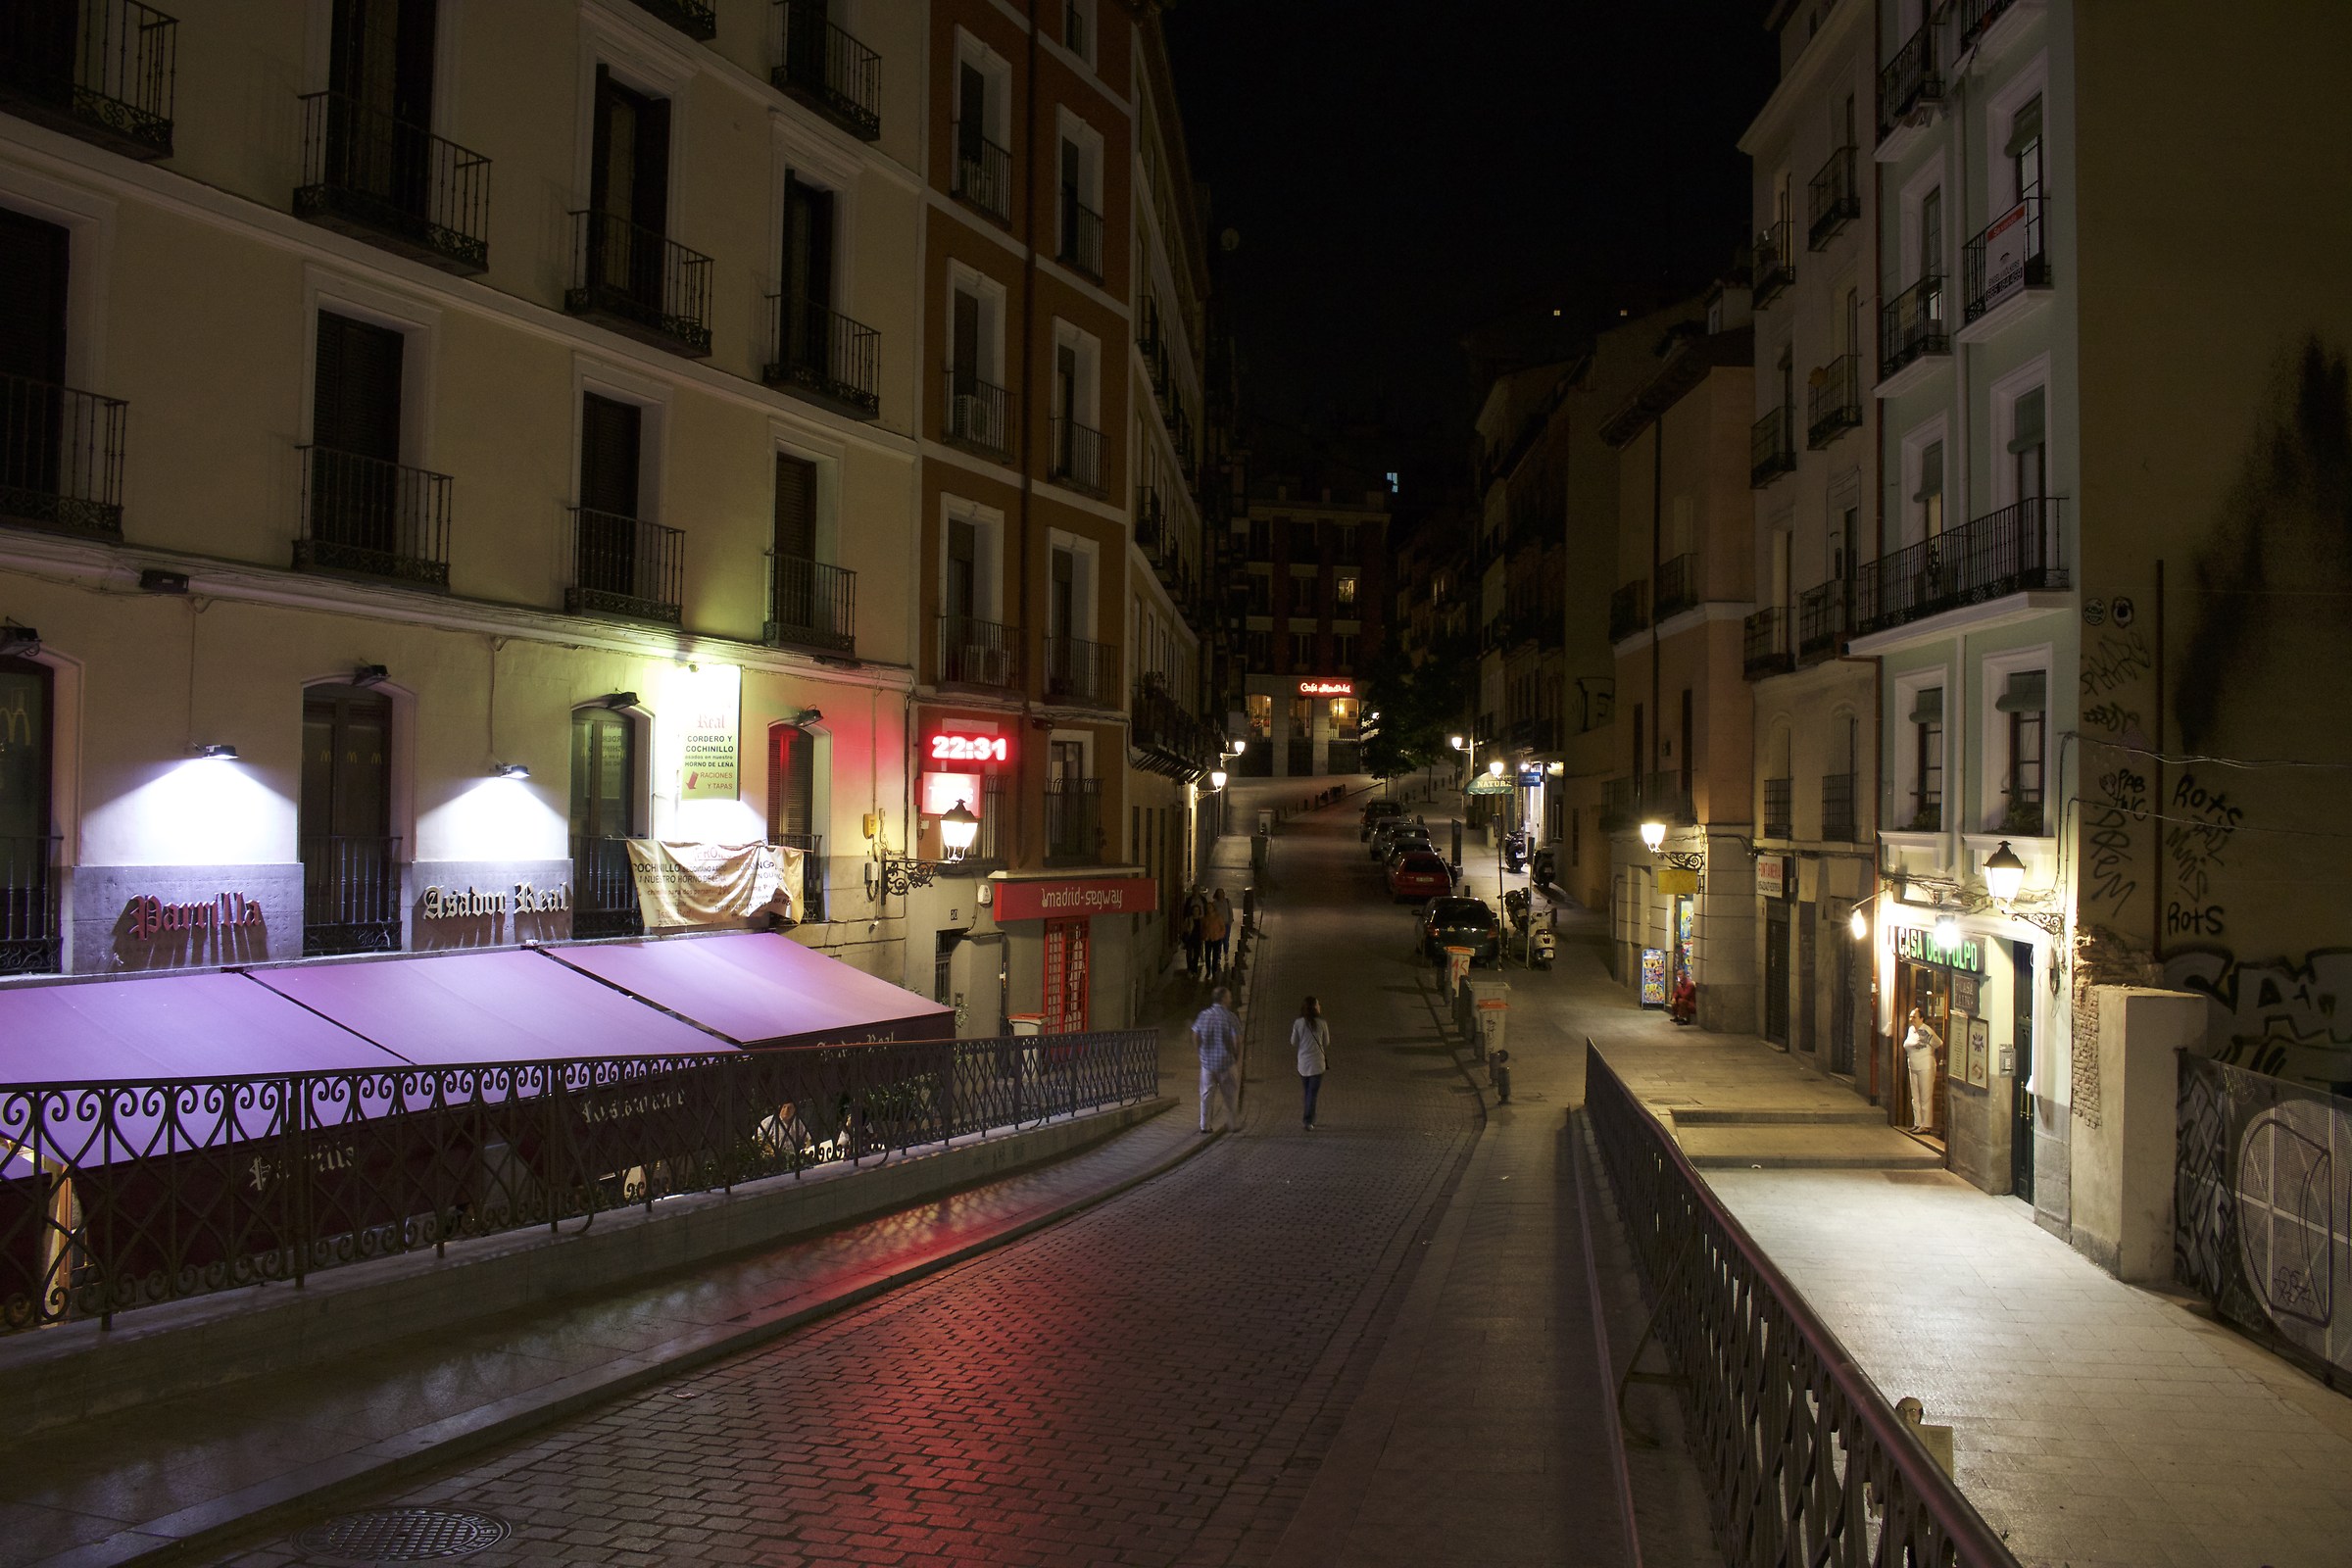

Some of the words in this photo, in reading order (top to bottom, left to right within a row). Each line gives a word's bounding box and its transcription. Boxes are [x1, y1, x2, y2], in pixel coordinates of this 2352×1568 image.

[1319, 683, 1350, 693] Madrid
[932, 735, 1006, 760] 22:31
[677, 874, 703, 883] HORNO
[423, 885, 508, 920] Asador
[514, 882, 569, 914] Real
[128, 890, 262, 941] Parrilla
[1897, 927, 1924, 959] CASA
